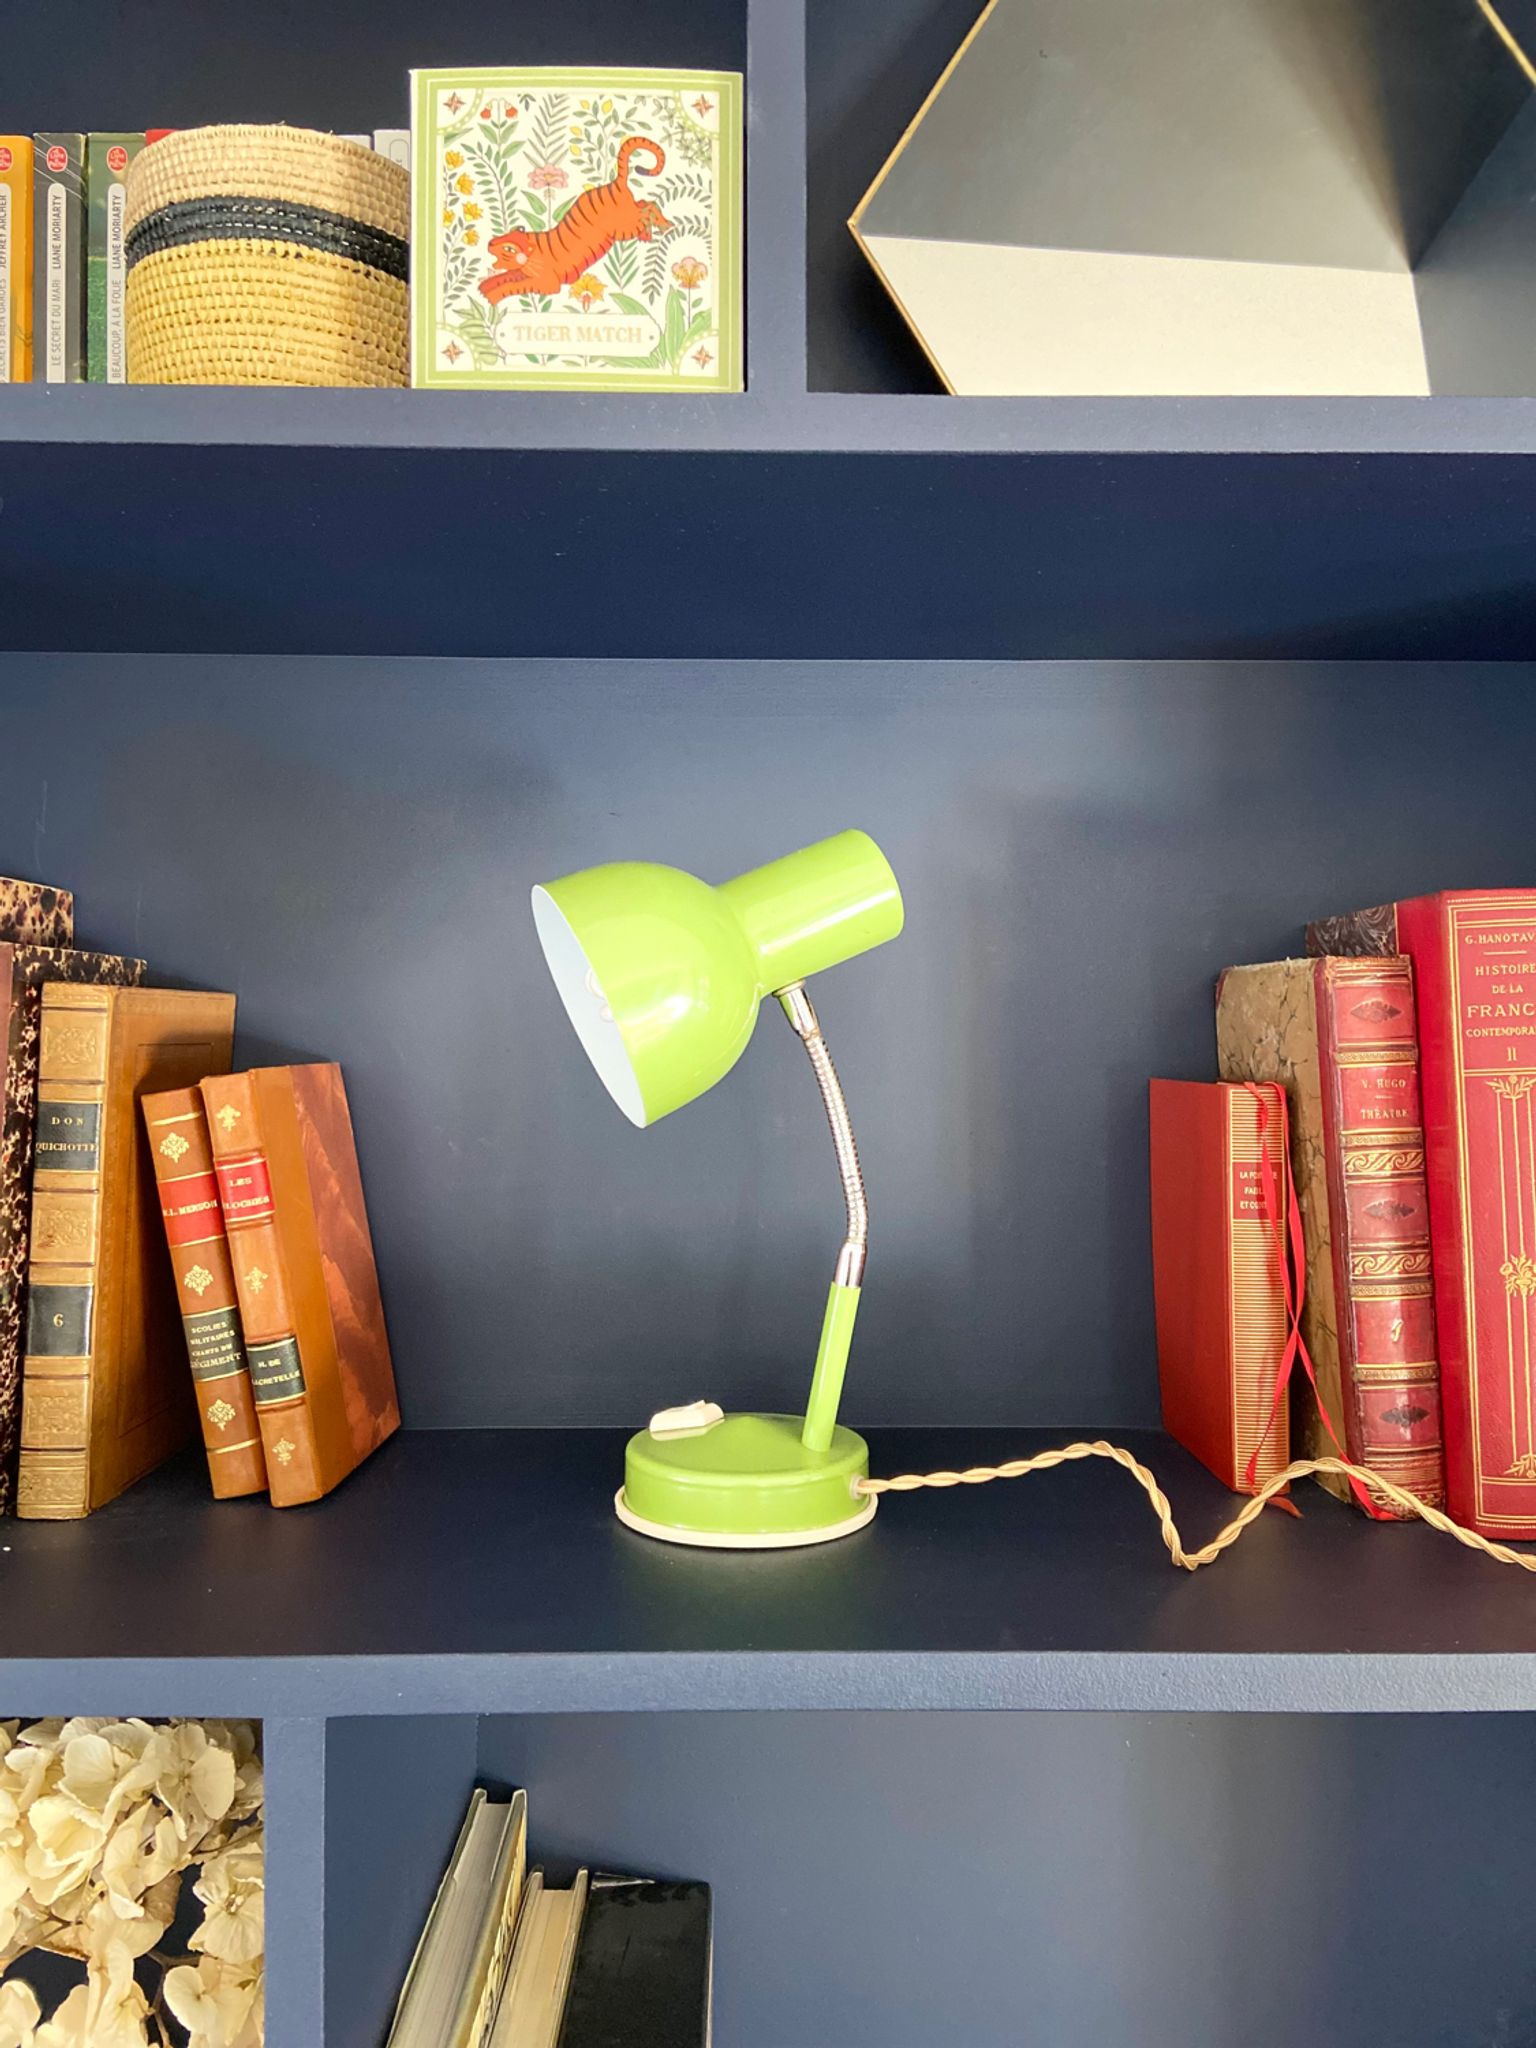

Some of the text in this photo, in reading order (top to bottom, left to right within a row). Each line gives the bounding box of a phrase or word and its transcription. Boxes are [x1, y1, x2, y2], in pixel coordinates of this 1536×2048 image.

[52, 195, 62, 269] LIANE MORIARTY
[112, 195, 121, 269] LIANE MORIARTY
[111, 279, 121, 304] FOLIE
[111, 306, 121, 318] LA
[51, 279, 61, 366] LE SECRET DU MARI
[513, 325, 642, 343] TIGER MATCH
[111, 329, 122, 378] BEAUCOUP,
[1475, 963, 1536, 976] HISTOIRE
[1492, 983, 1524, 994] DE LA
[1467, 1003, 1536, 1018] FRANC
[1466, 1026, 1536, 1037] CONTEMPORA
[1376, 1078, 1407, 1089] HUGO
[51, 1116, 84, 1127] DON
[35, 1142, 97, 1155] QUICHOTTE
[229, 1177, 252, 1187] LES
[223, 1195, 270, 1210] LOCHES
[53, 1313, 64, 1328] 6
